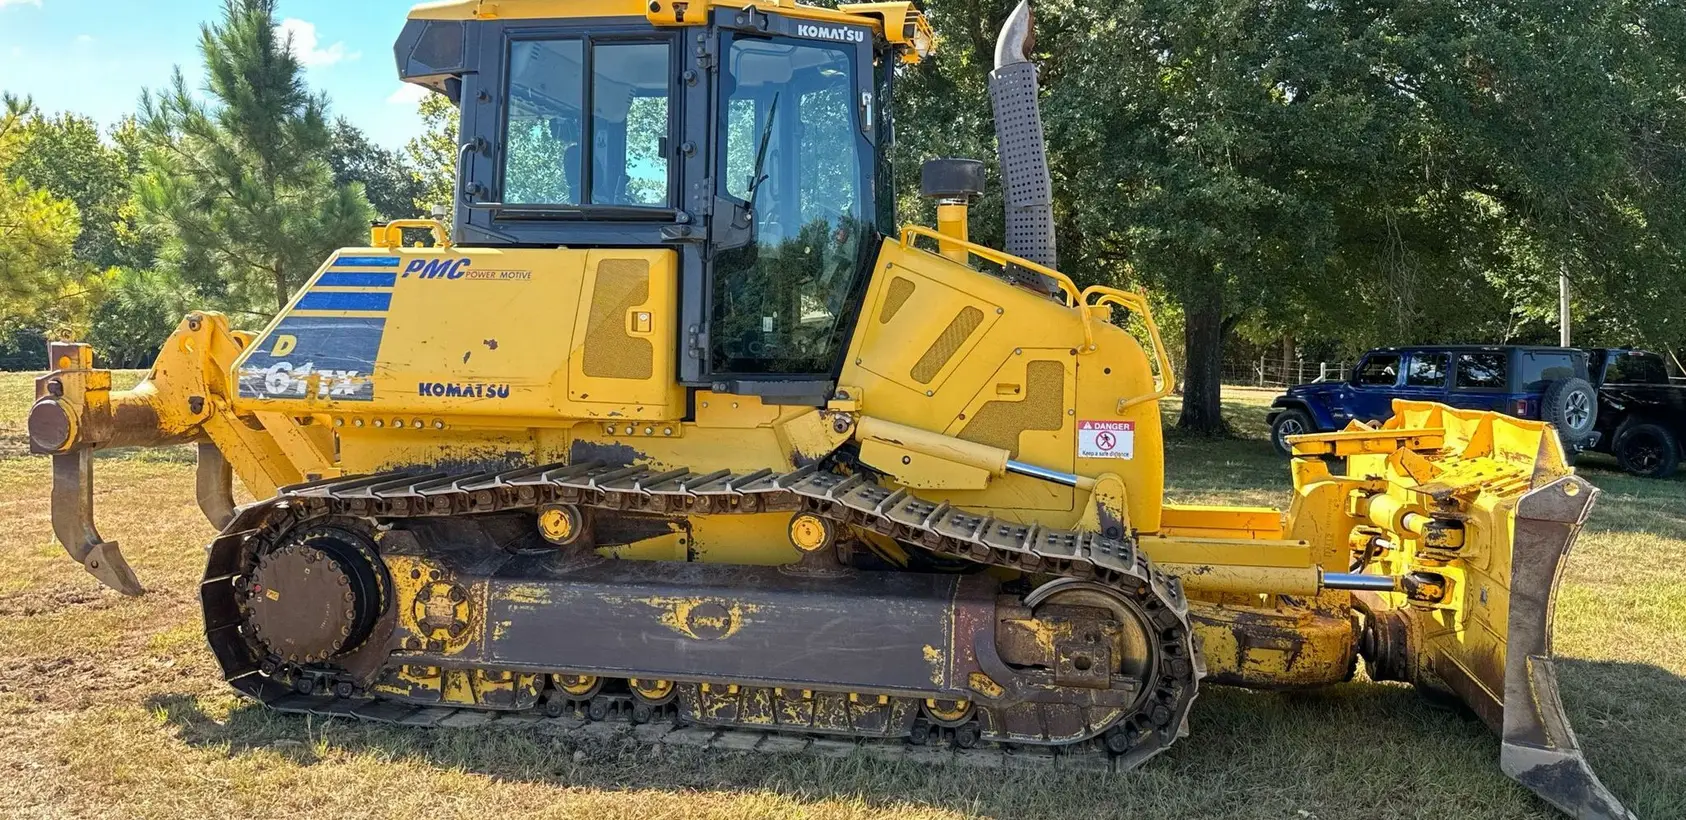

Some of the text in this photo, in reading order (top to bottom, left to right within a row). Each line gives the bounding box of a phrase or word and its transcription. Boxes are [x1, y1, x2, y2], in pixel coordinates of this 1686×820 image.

[798, 24, 864, 42] KOMATSU
[401, 258, 532, 280] PMC POWER MOTIVE
[270, 334, 297, 357] D
[418, 382, 510, 399] KOMATSU
[1094, 423, 1130, 431] DANGER
